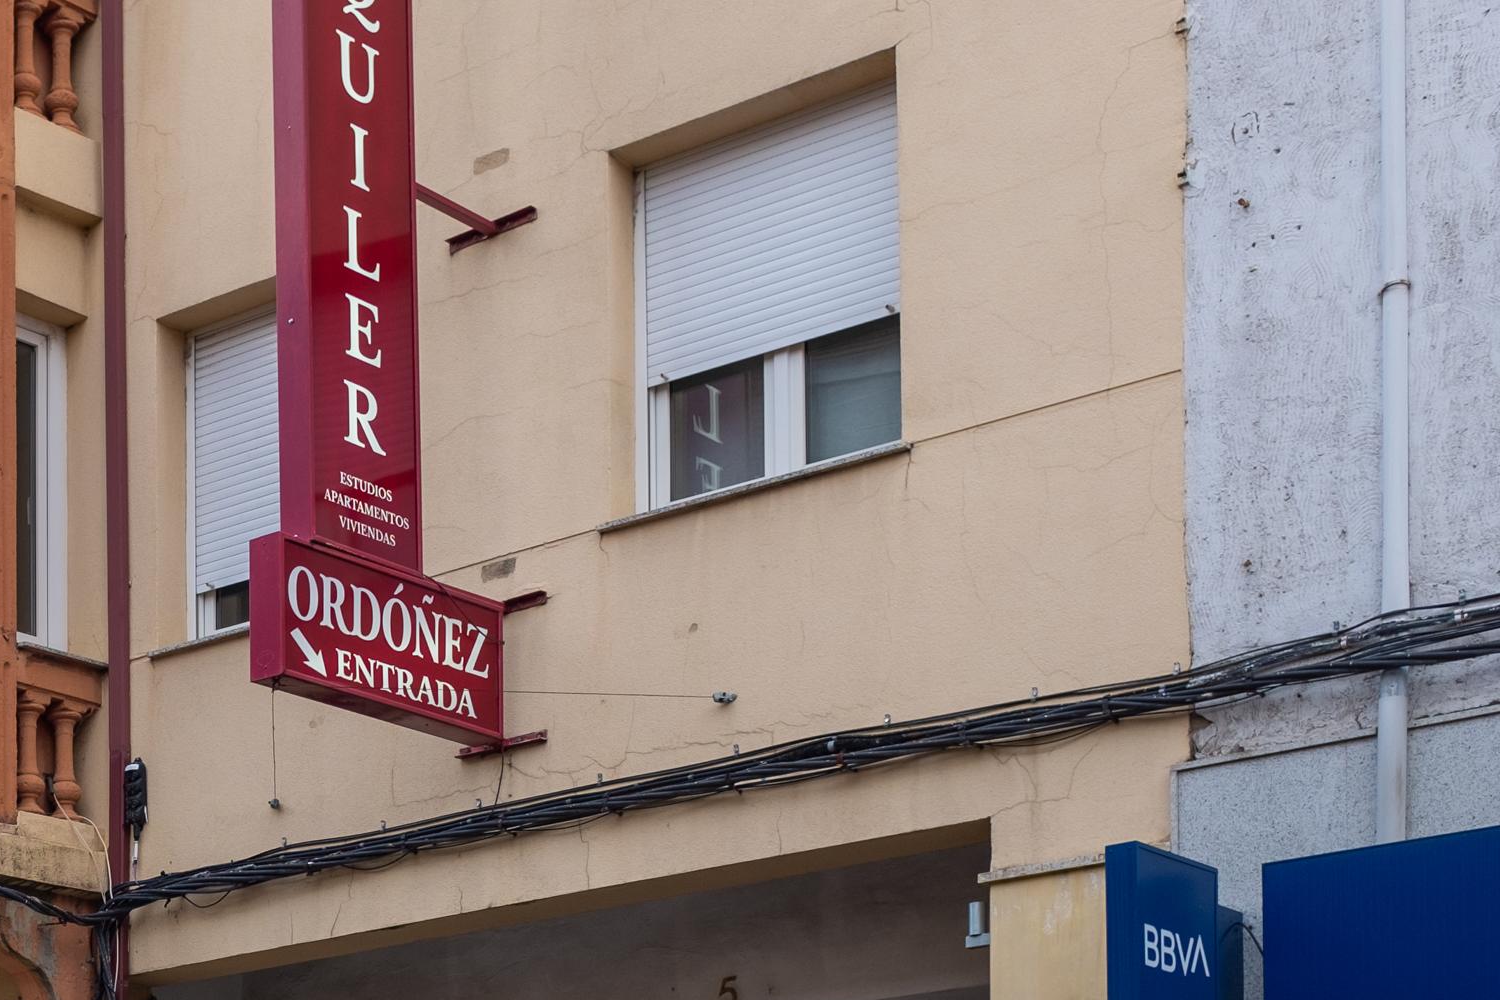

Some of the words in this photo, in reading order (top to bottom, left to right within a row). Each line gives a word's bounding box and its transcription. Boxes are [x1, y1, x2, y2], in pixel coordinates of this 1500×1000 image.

[323, 488, 410, 530] APARTAMENTOS
[339, 470, 393, 502] ESTUDIOS
[338, 514, 396, 547] VIVIENDAS
[287, 565, 489, 679] ORDÓÑEZ
[335, 647, 478, 719] ENTRADA
[1143, 922, 1211, 977] BBVA
